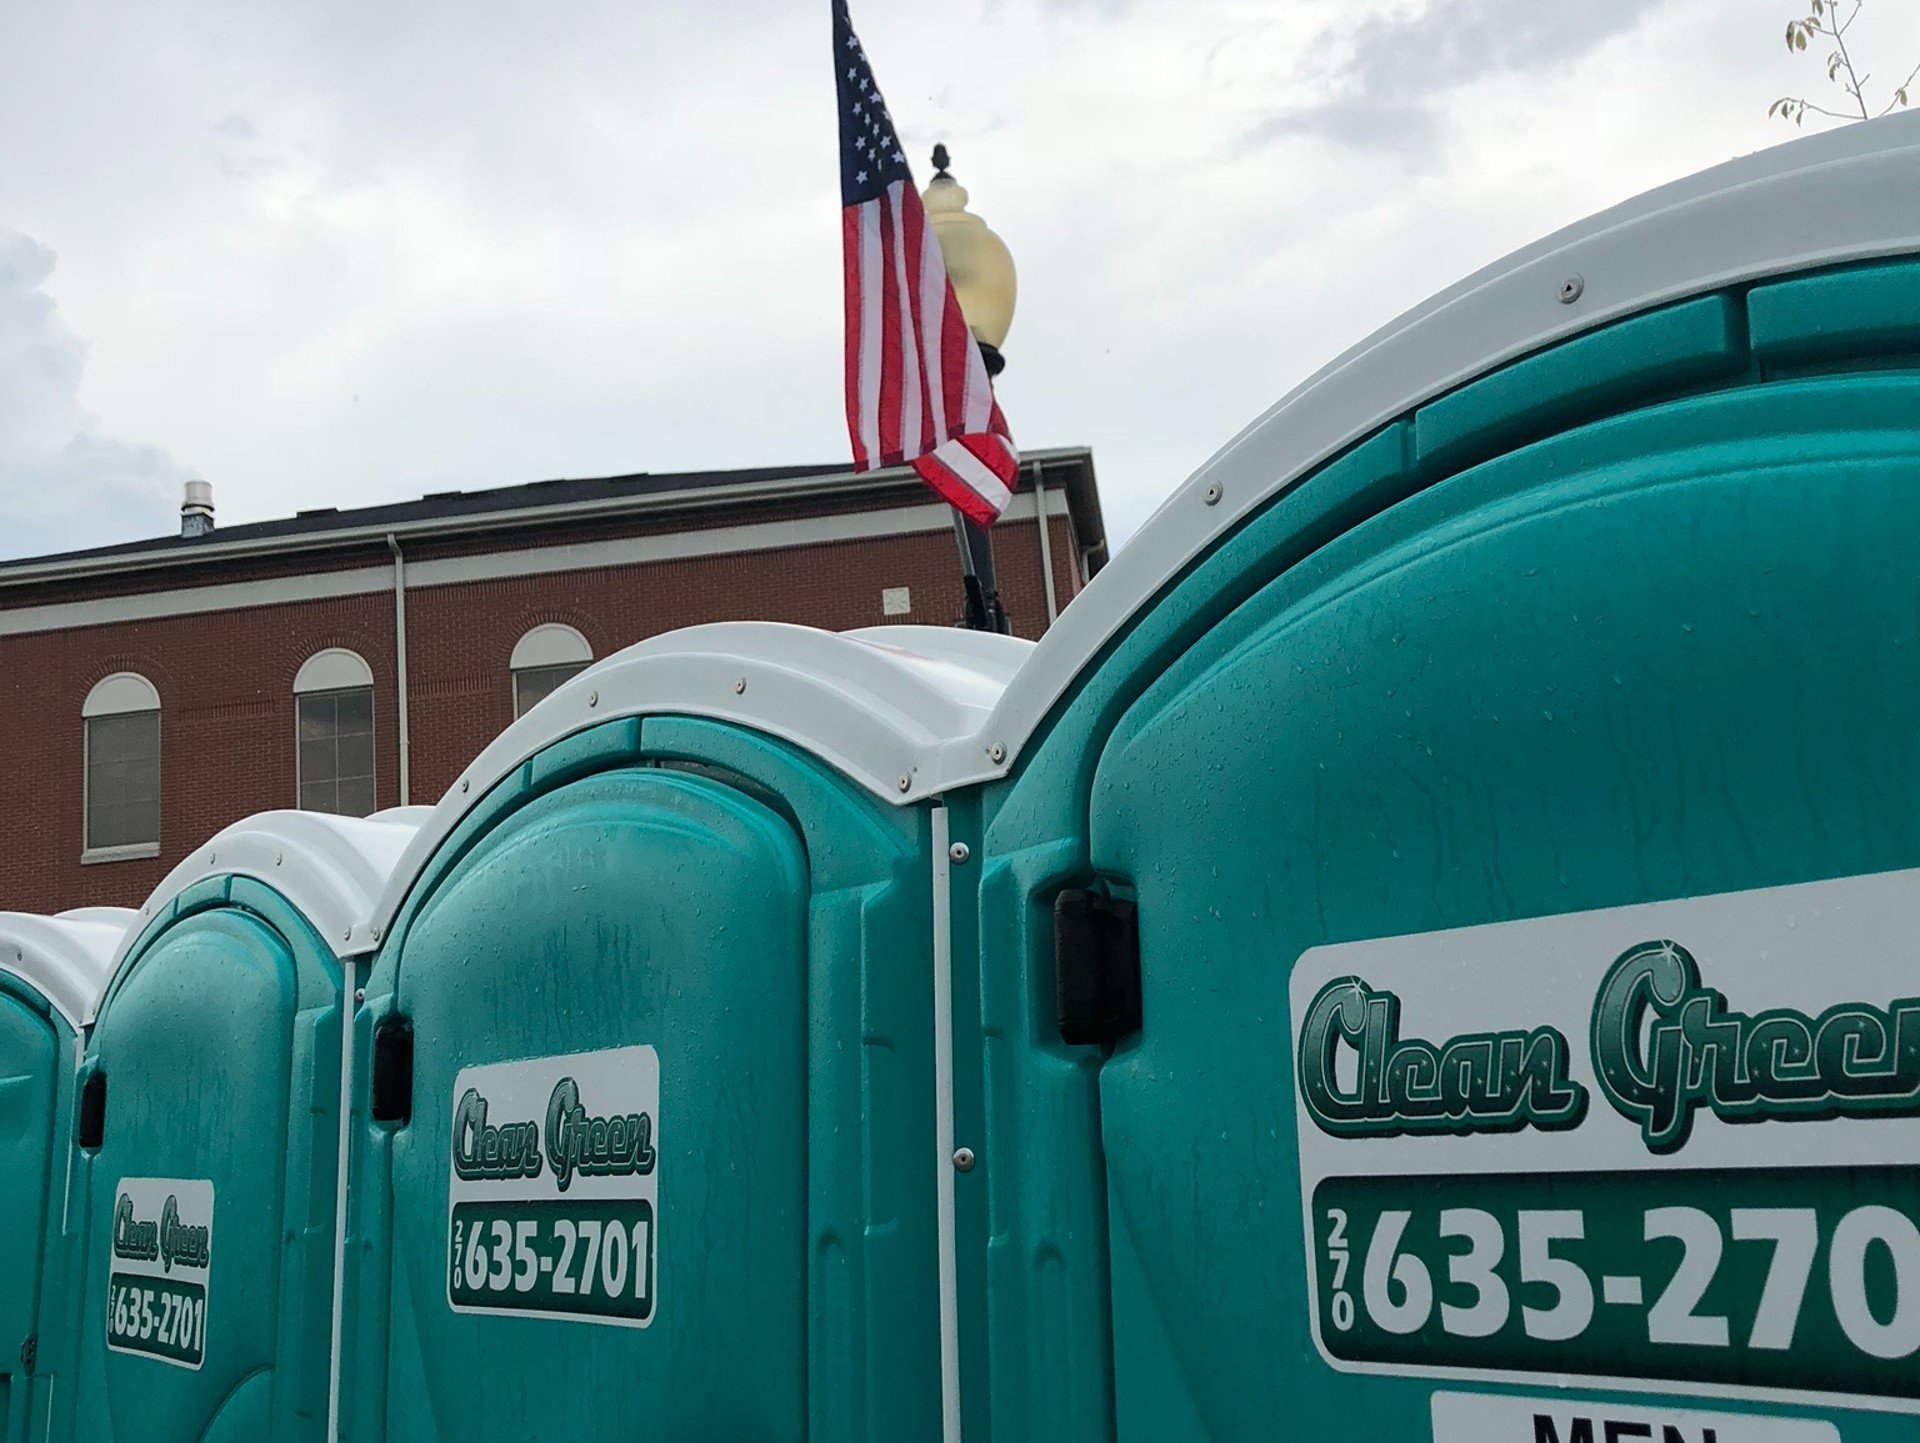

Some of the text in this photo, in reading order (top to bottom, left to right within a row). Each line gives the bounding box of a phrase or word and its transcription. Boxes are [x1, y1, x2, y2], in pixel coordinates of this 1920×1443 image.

[1300, 974, 1590, 1139] Clean
[453, 1076, 656, 1192] Clean Green
[113, 1192, 210, 1274] Clean Green
[453, 1218, 649, 1300] 270 635-2701
[1326, 1208, 1355, 1333] 270
[114, 1286, 204, 1352] 635-2701
